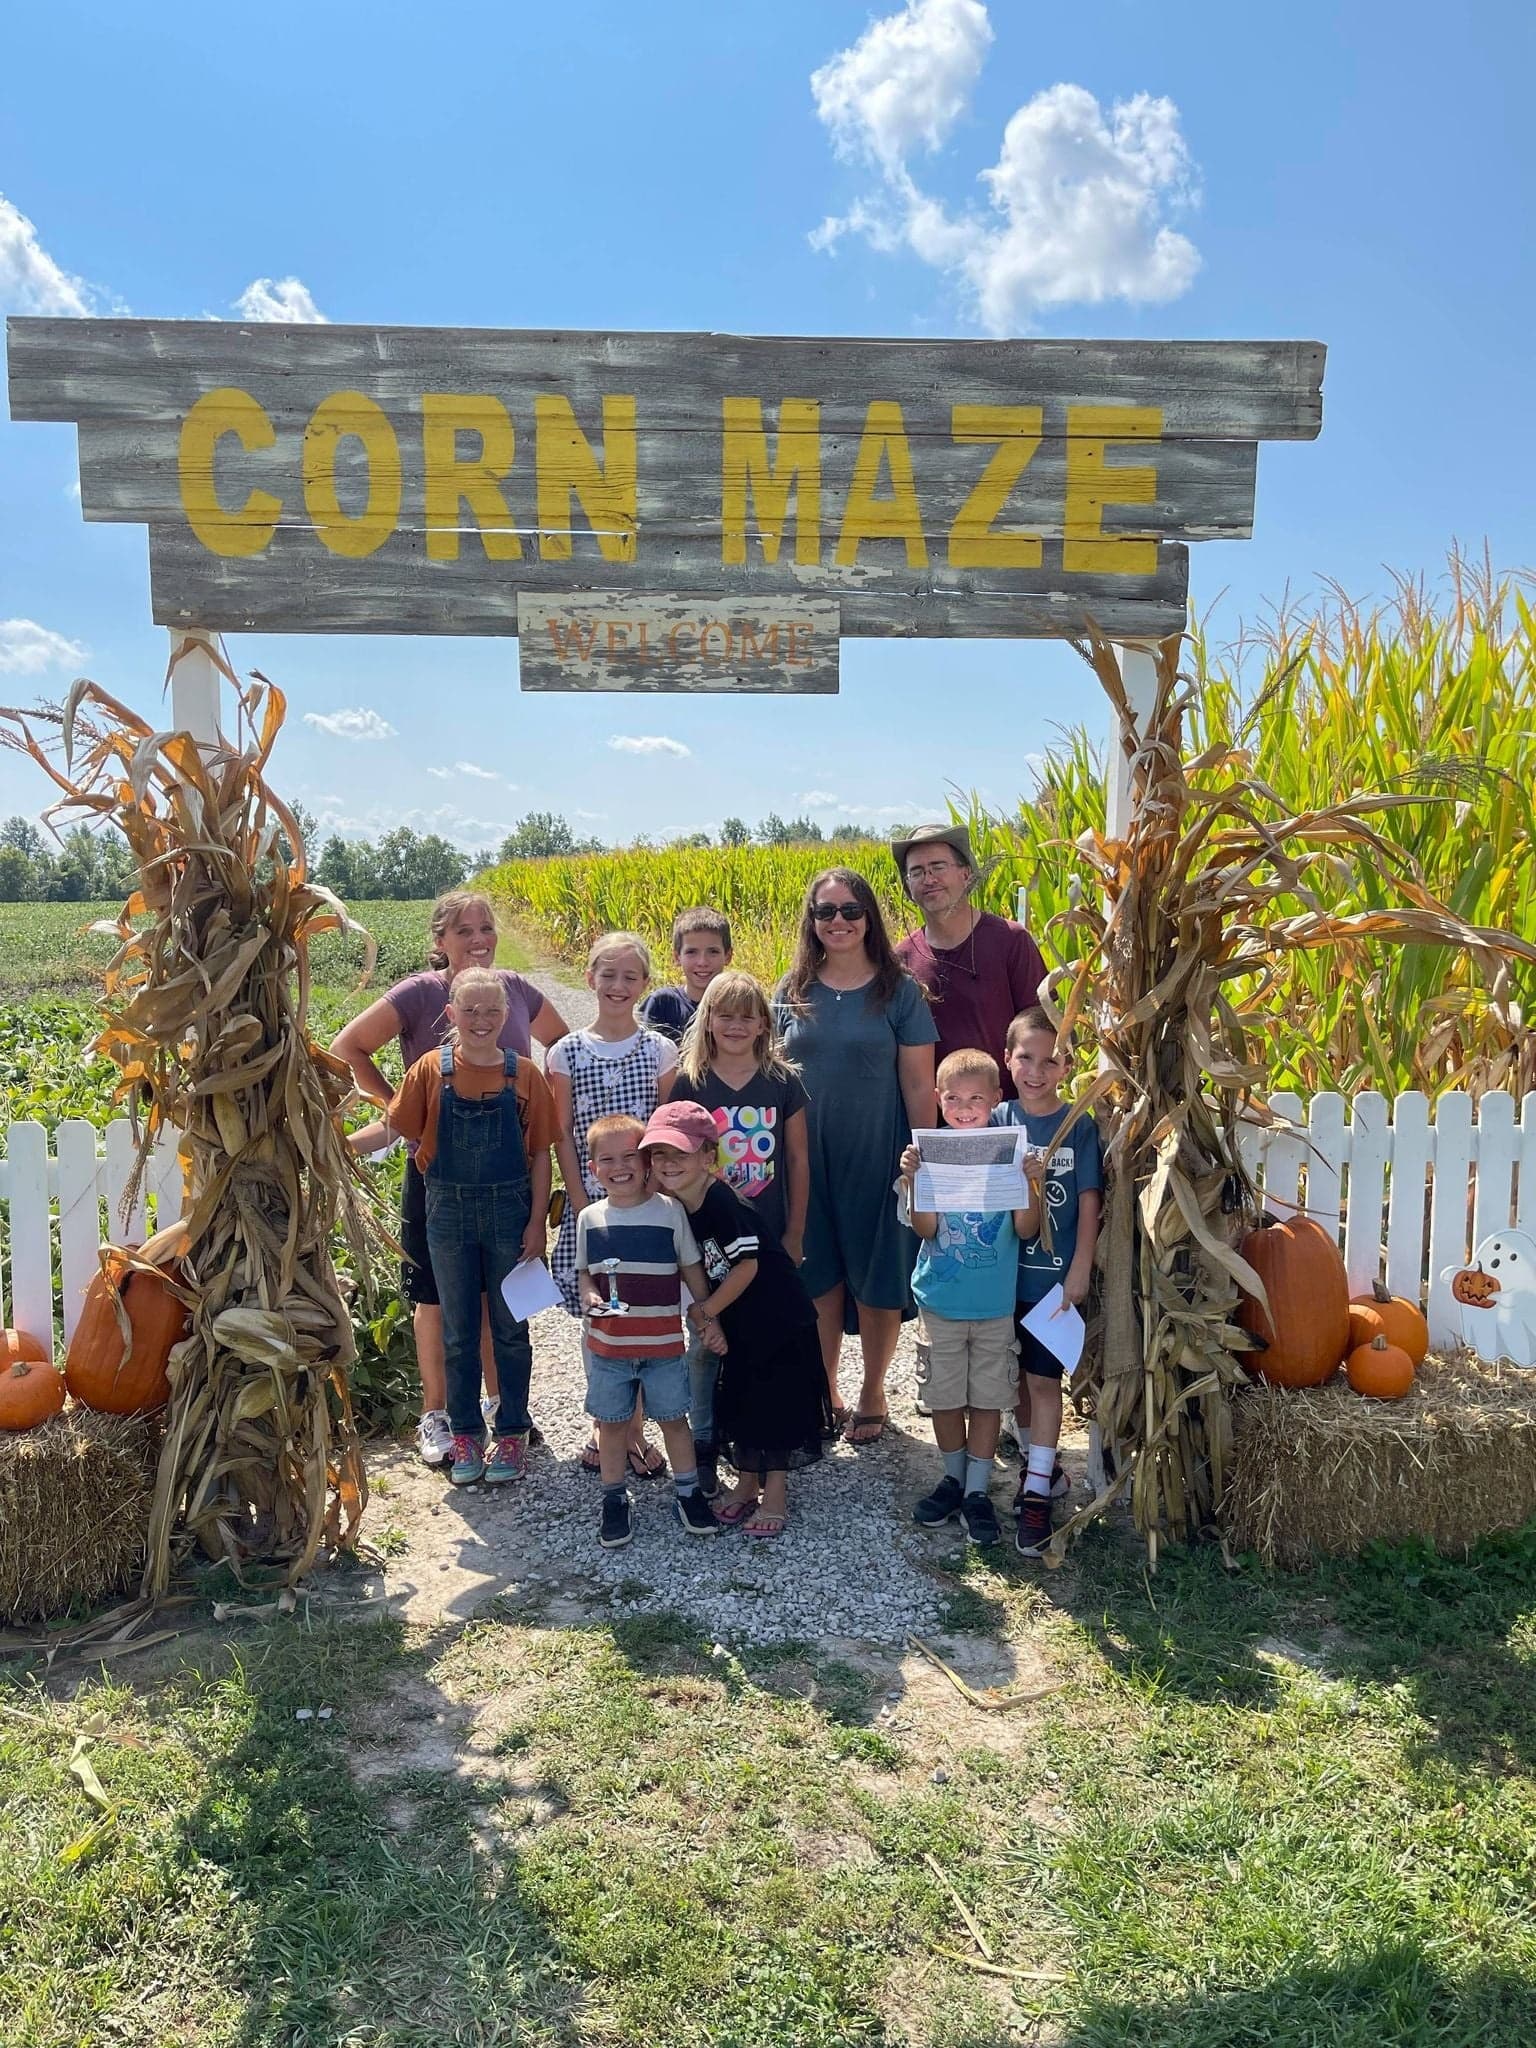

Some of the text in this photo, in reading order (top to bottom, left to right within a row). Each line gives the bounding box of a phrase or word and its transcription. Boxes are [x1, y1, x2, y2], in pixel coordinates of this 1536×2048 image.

[178, 387, 1163, 575] CORN MAZE
[546, 617, 815, 668] WELCOME
[721, 1105, 777, 1129] YOU
[720, 1130, 776, 1159] GO
[1051, 1157, 1073, 1168] BACK!
